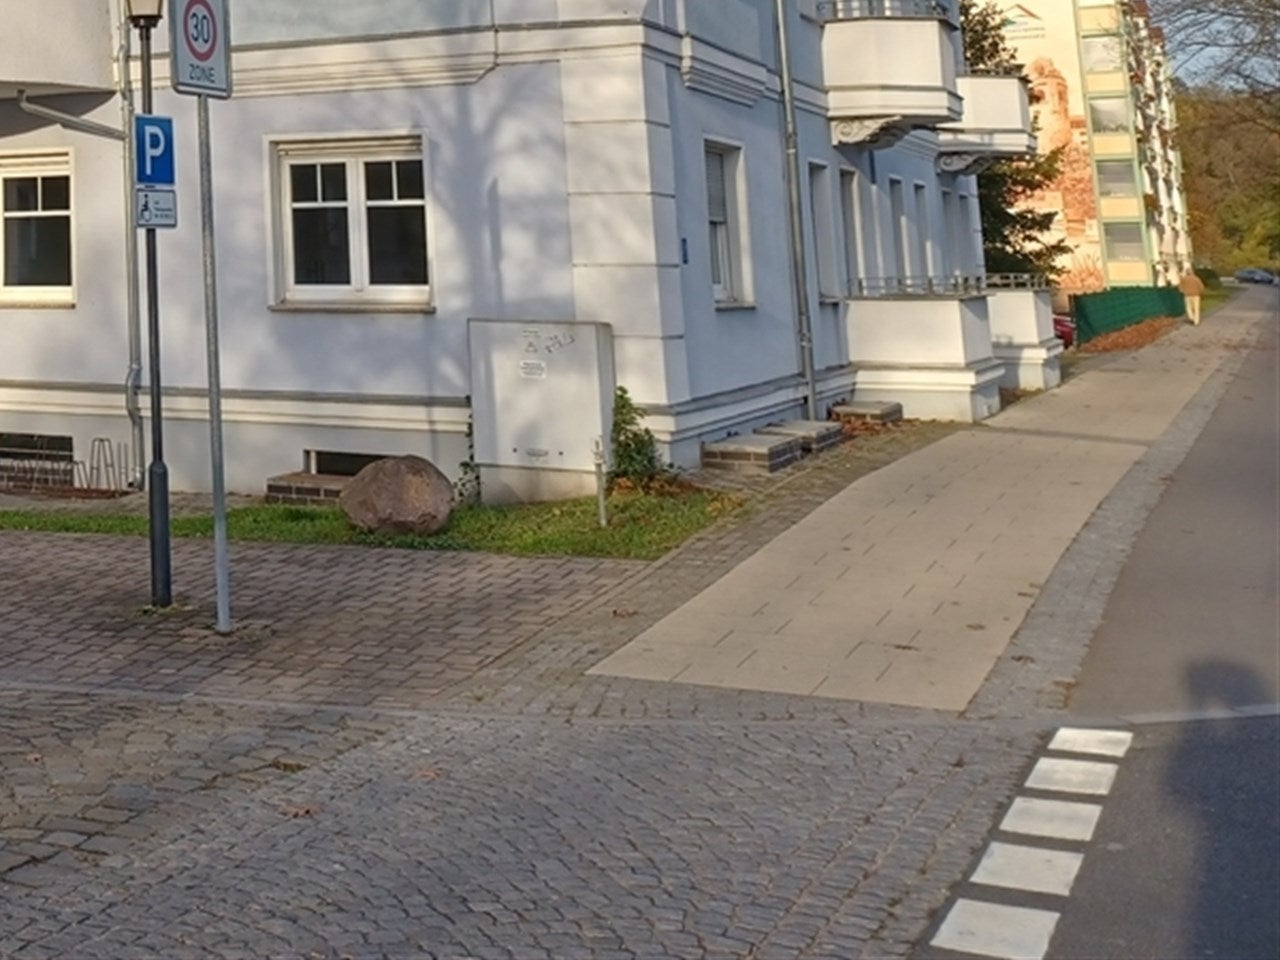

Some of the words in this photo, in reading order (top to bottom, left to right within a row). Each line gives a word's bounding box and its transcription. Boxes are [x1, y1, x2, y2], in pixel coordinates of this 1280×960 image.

[190, 12, 210, 43] 30
[189, 63, 216, 83] ZONE
[144, 125, 165, 175] P
